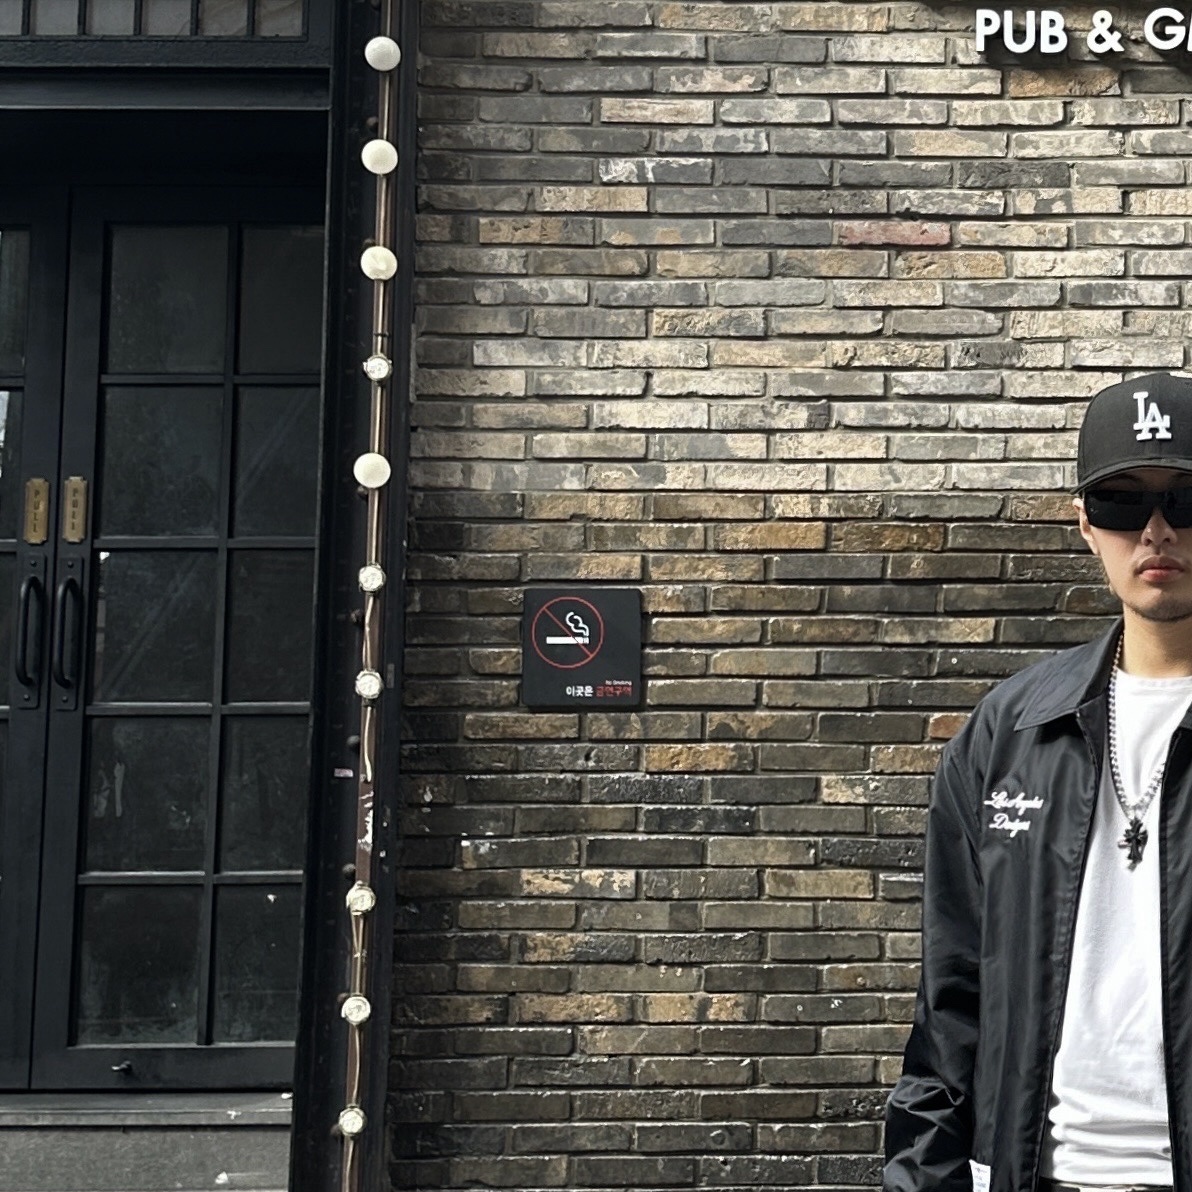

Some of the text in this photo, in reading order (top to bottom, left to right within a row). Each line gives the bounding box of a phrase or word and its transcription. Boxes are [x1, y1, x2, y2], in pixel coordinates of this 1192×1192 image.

[975, 8, 1069, 54] PUB
[1086, 9, 1125, 54] &
[1132, 390, 1173, 442] LA
[565, 685, 594, 697] 이곳은
